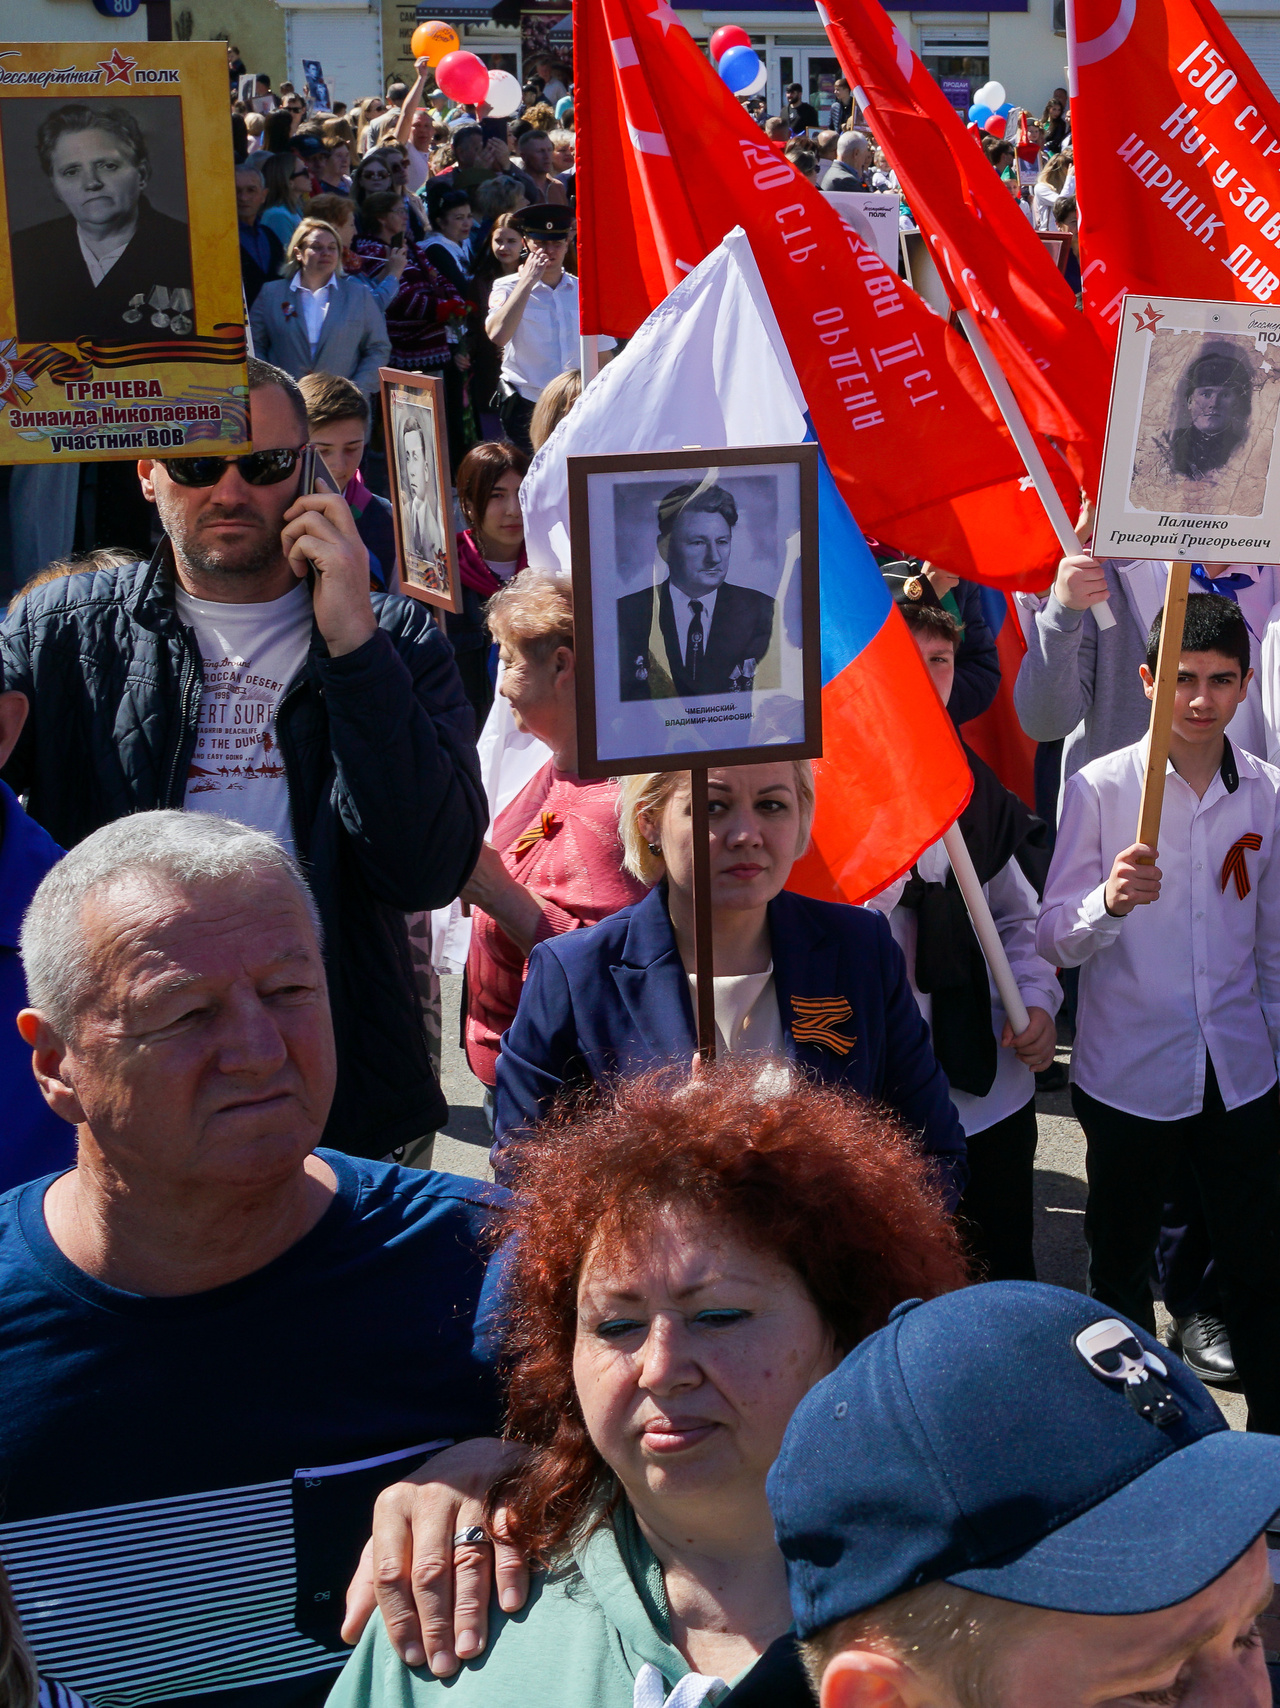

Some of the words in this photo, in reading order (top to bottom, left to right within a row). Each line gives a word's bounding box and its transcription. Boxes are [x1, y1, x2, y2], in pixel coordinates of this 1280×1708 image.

[0, 51, 103, 88] ессмертный
[135, 70, 181, 83] ПОЛК
[1177, 40, 1238, 105] 150
[65, 379, 164, 400] ГРЯЧЕВА
[9, 408, 98, 428] Зинаида
[101, 404, 222, 425] Николаевна
[51, 432, 143, 453] участник
[146, 428, 185, 448] ВОВ
[1157, 515, 1229, 530] Палиенко
[1109, 531, 1179, 546] Григорий
[1180, 533, 1271, 549] Григорьевич
[202, 658, 219, 671] ang
[203, 671, 242, 684] ROCCAN
[245, 675, 284, 692] DESERT
[198, 703, 227, 724] ERT
[685, 703, 736, 714] ЧМЕЛИНСКИЙ
[665, 717, 706, 727] ВЛАДИМИР
[708, 713, 755, 723] ИОСИФОВИЧ
[211, 738, 230, 749] THE
